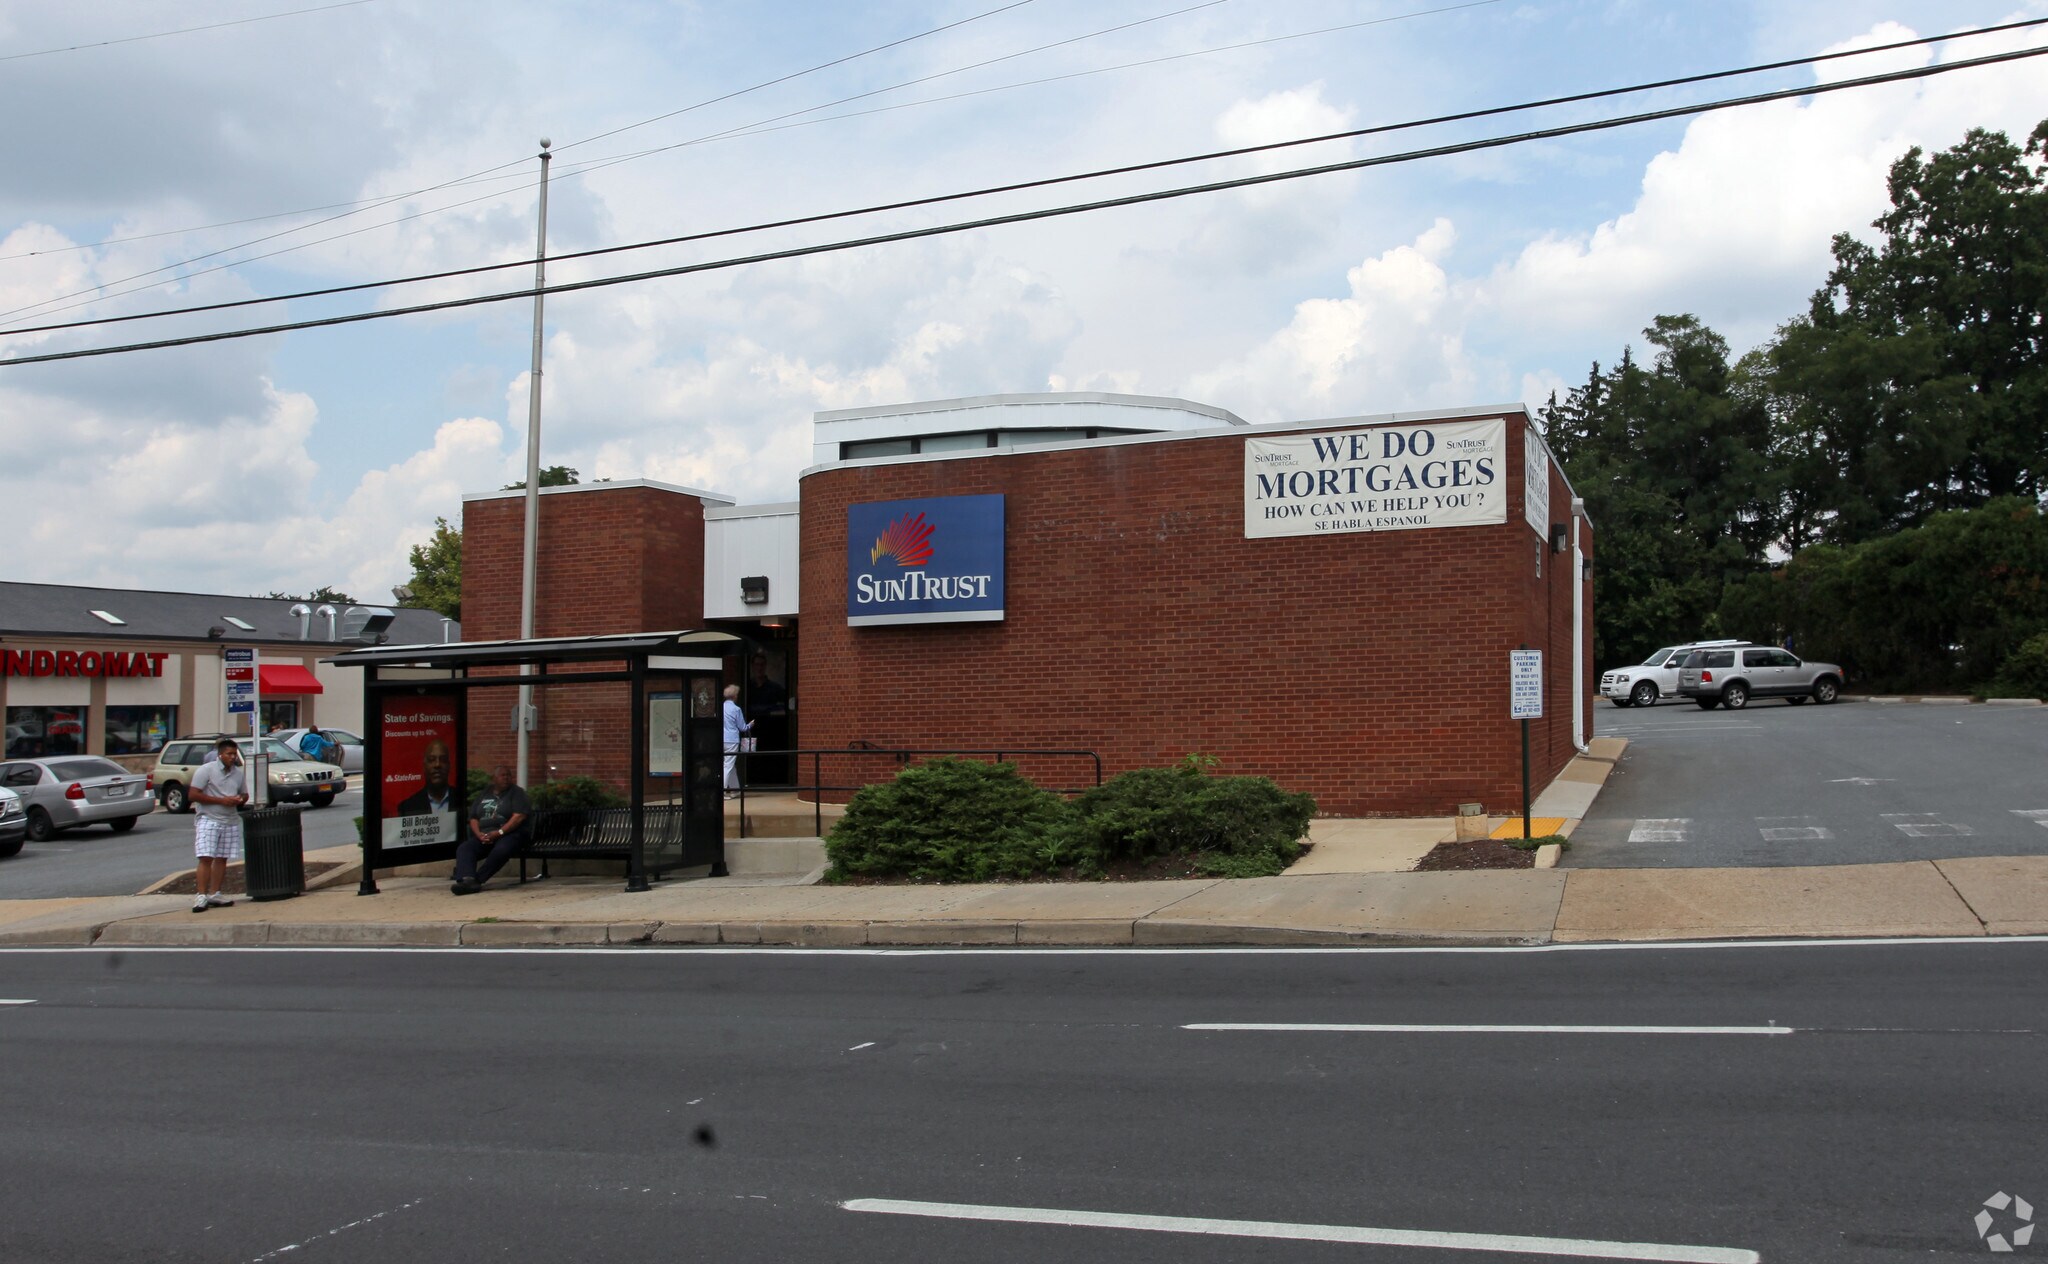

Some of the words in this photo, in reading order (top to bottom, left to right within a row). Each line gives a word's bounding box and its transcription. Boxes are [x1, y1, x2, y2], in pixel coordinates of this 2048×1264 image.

[1311, 433, 1370, 463] WE
[1381, 429, 1435, 459] DO
[1255, 457, 1495, 500] MORTGAGES
[1264, 504, 1305, 519] HOW
[1310, 501, 1345, 516] CAN
[1351, 499, 1378, 513] WE
[1383, 496, 1429, 512] HELP
[1434, 493, 1471, 508] YOU
[1315, 520, 1329, 530] SE
[1332, 518, 1373, 529] HABLA
[1376, 515, 1431, 527] ESPANOL
[0, 648, 169, 678] NDROMAT
[384, 713, 407, 723] State
[409, 713, 418, 722] of
[402, 817, 413, 828] Bill
[414, 815, 439, 827] Bridges
